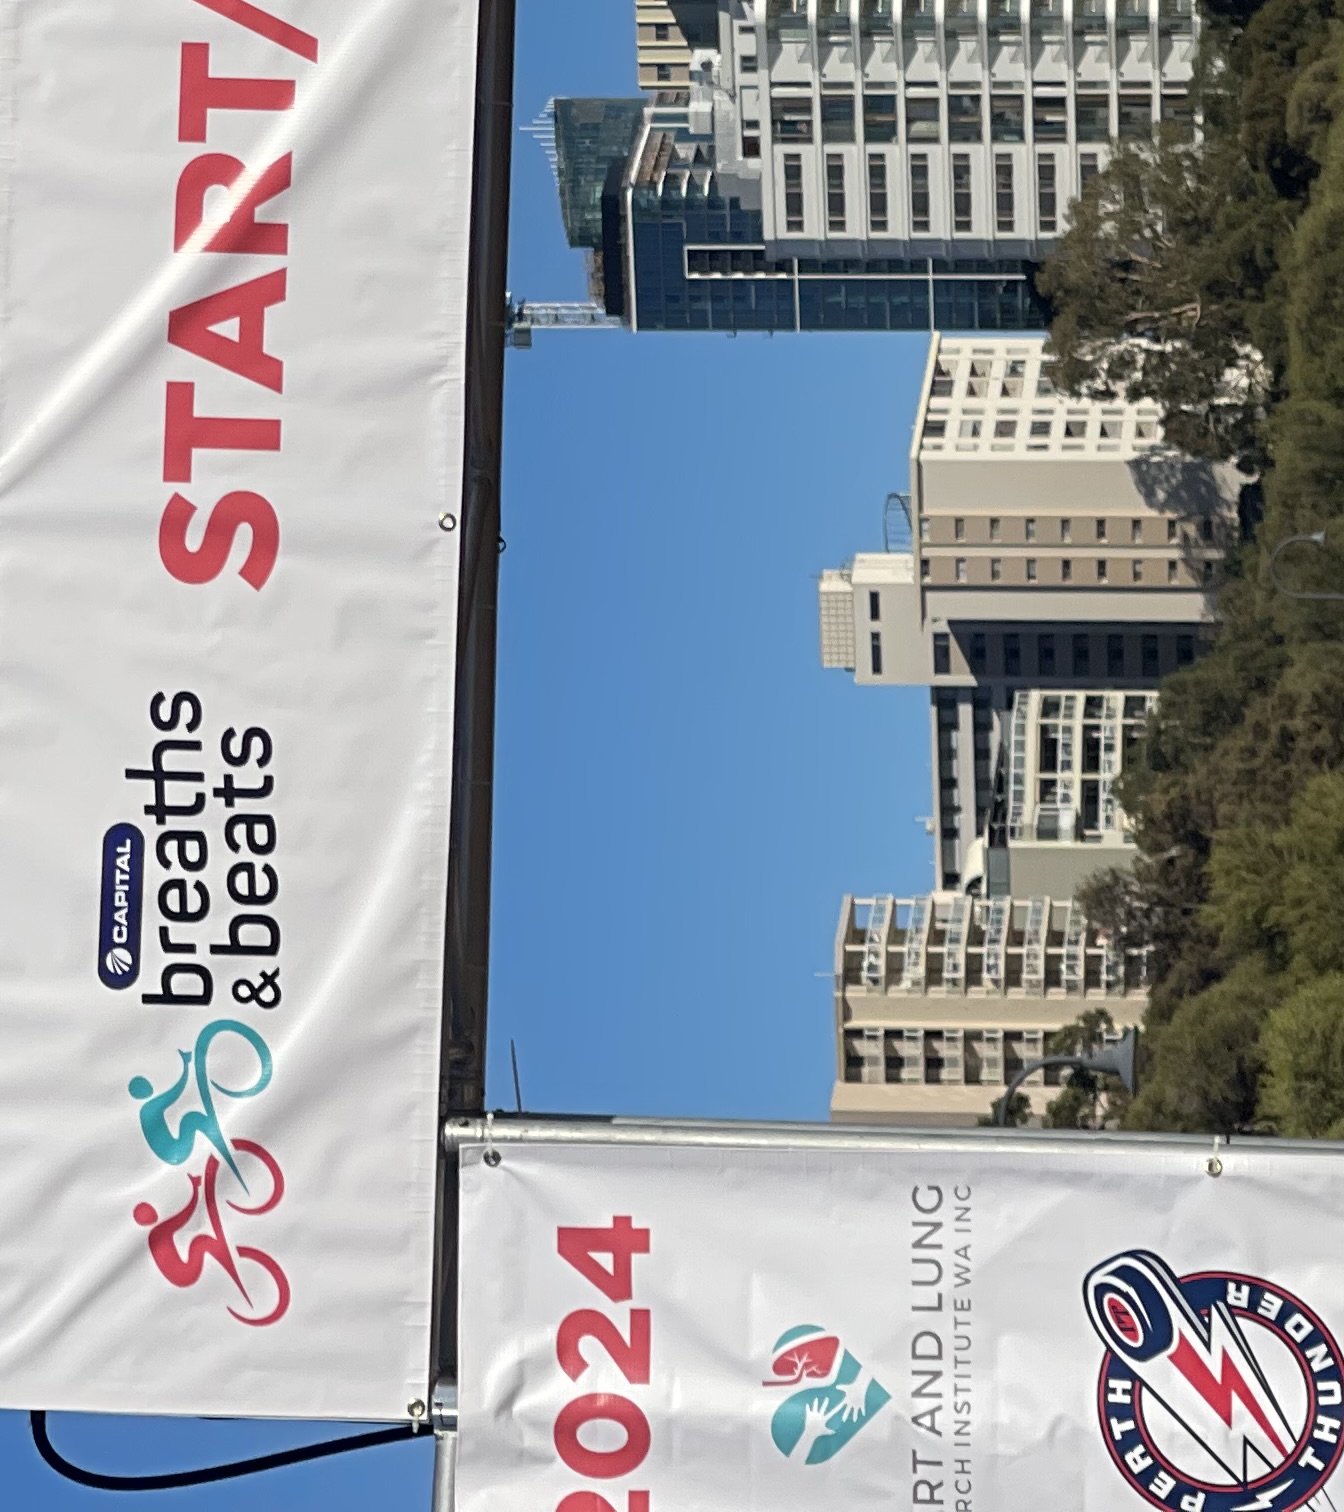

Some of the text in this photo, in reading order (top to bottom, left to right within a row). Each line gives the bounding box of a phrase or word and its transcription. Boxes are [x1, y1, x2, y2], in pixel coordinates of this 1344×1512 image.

[111, 839, 132, 944] CAPITAL
[124, 691, 213, 1005] breaths
[911, 1184, 944, 1313] LUNG
[953, 1184, 972, 1233] INC
[953, 1244, 972, 1288] WA
[911, 1331, 944, 1436] AND
[953, 1298, 973, 1447] INSTITUTE
[1225, 1281, 1343, 1470] THUNDER
[1107, 1378, 1206, 1512] PERTH
